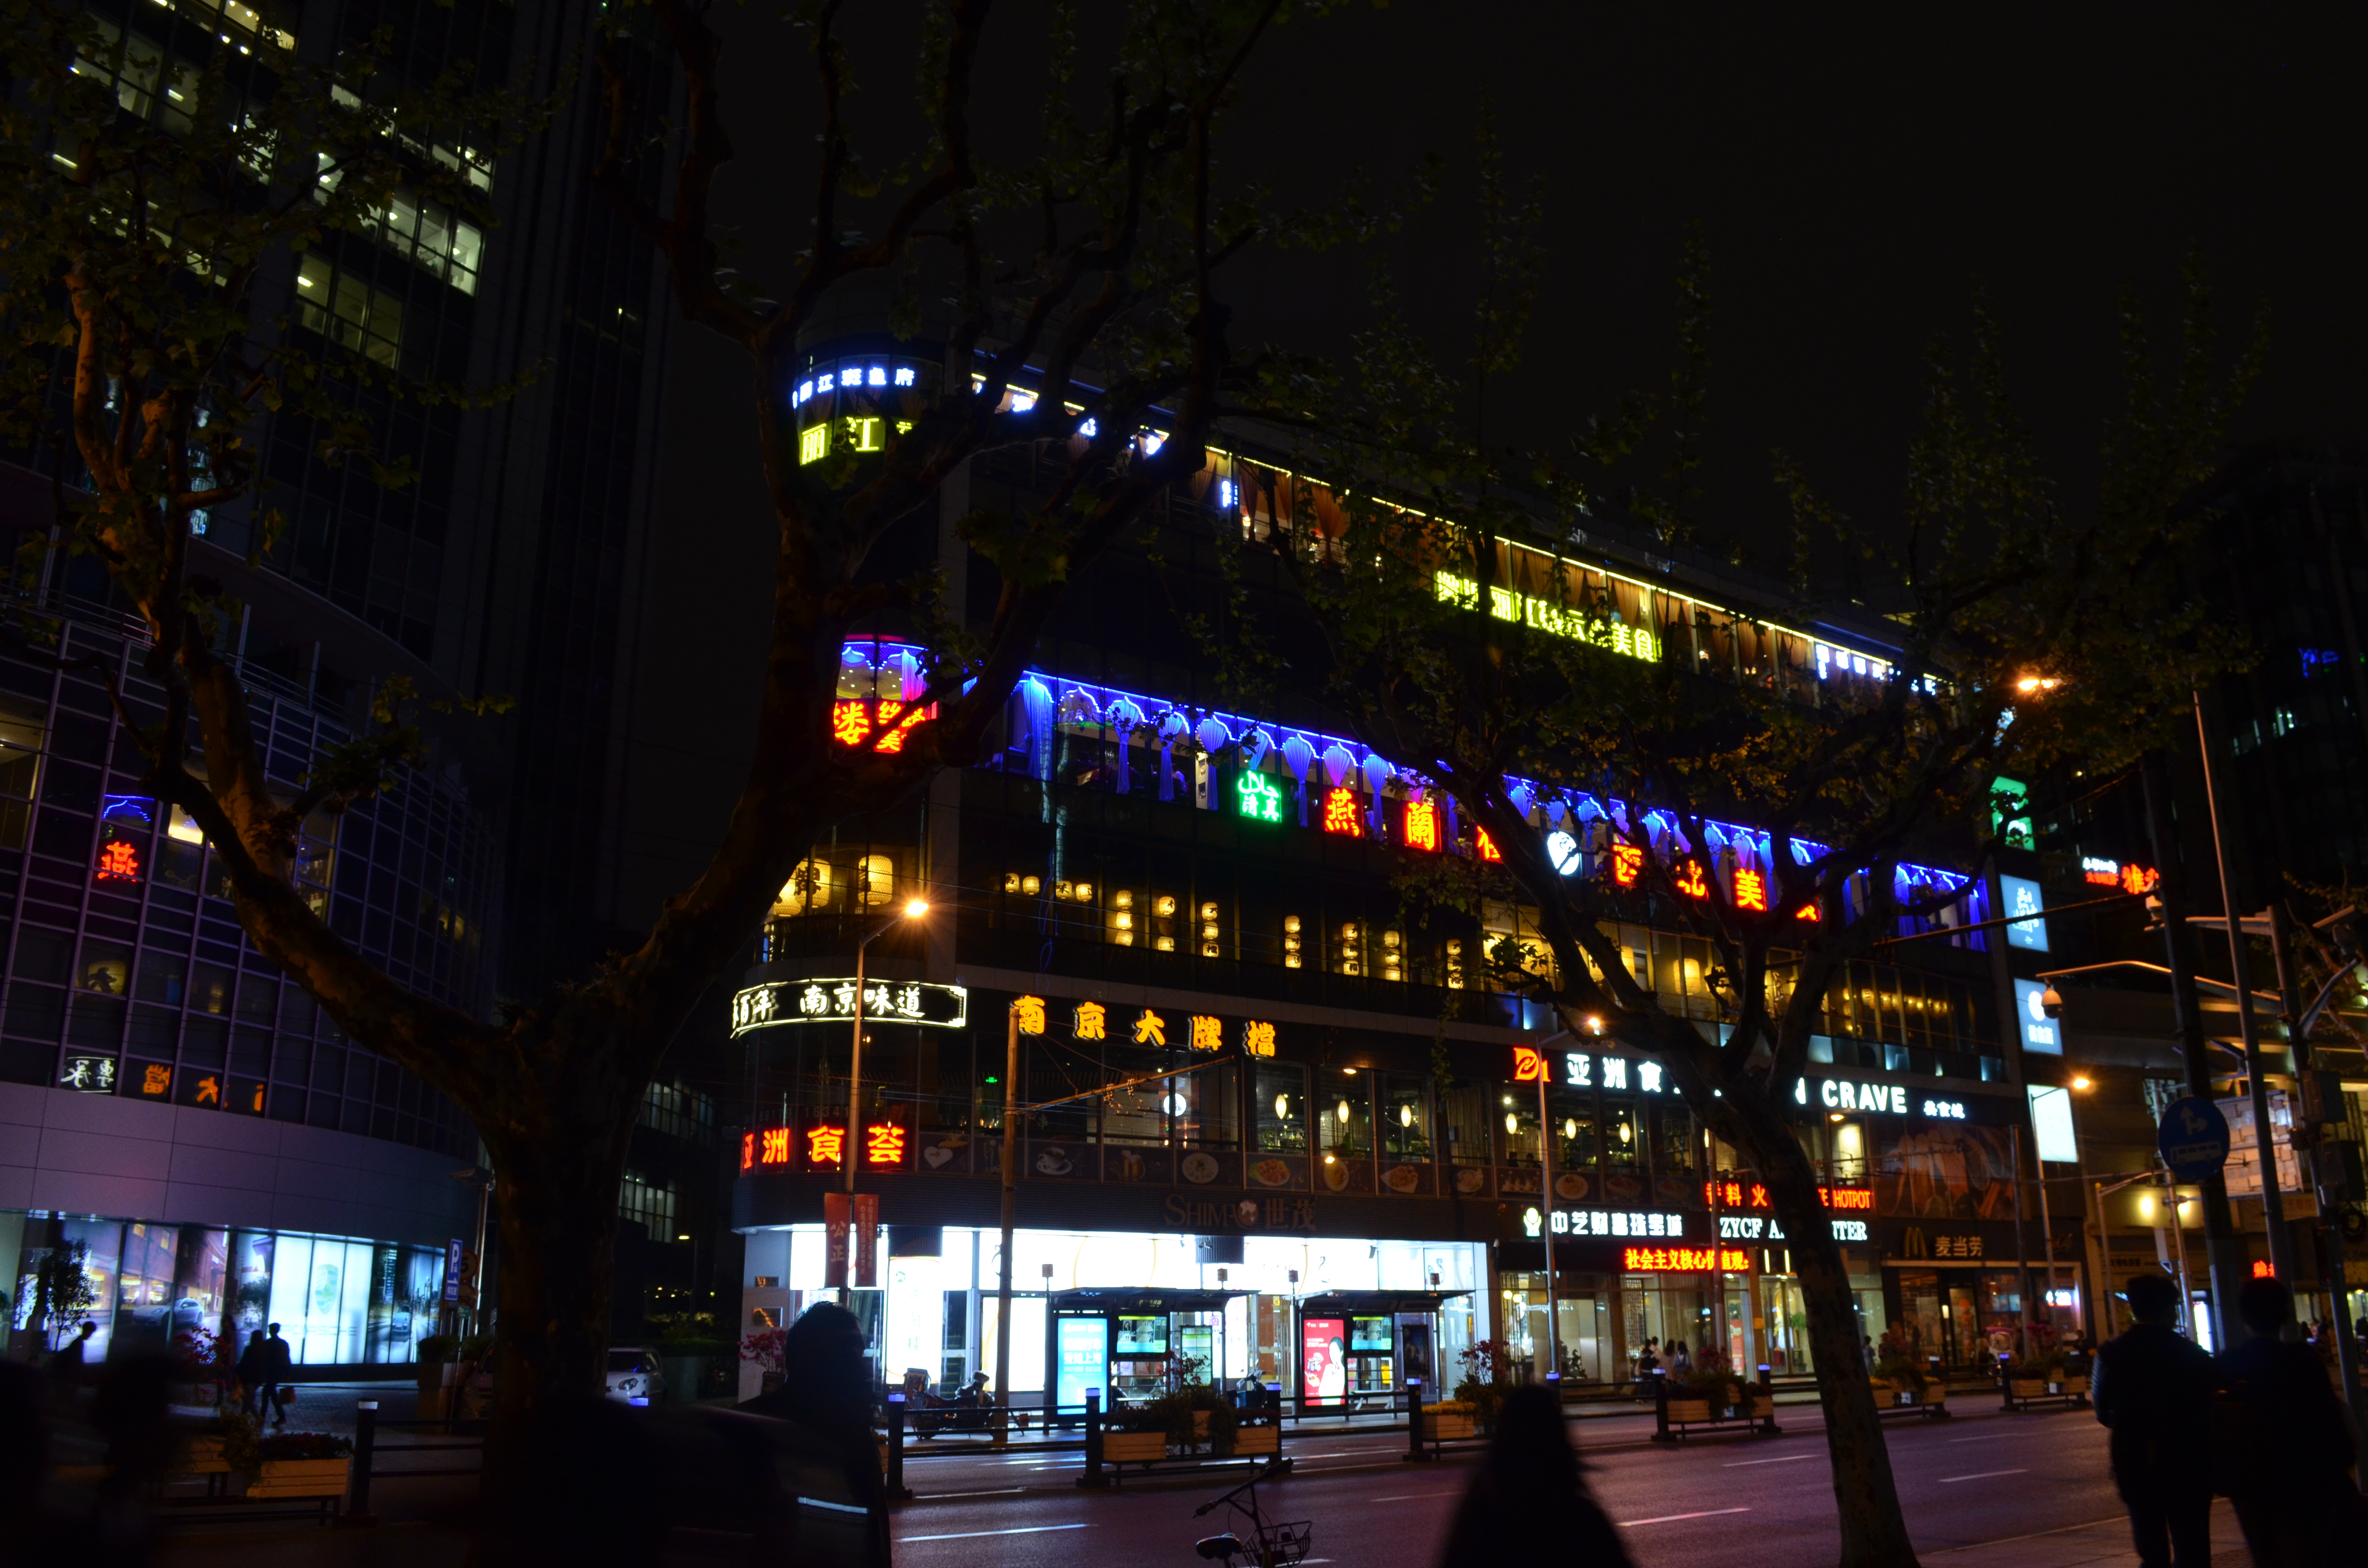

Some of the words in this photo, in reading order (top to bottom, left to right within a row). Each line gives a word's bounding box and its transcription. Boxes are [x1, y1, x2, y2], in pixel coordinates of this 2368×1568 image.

[1242, 794, 1280, 821] 清真
[800, 982, 925, 1017] 南京味道
[1014, 995, 1276, 1057] 南京大牌檔
[1822, 1080, 1907, 1113] CRAVE
[744, 1125, 905, 1169] 亚洲食荟
[1265, 1198, 1317, 1231] 世茂
[1833, 1189, 1871, 1209] HOTPOT
[829, 1220, 846, 1262] 公正
[1719, 1217, 1763, 1239] ZYCF
[1935, 1236, 1984, 1257] 麦当劳
